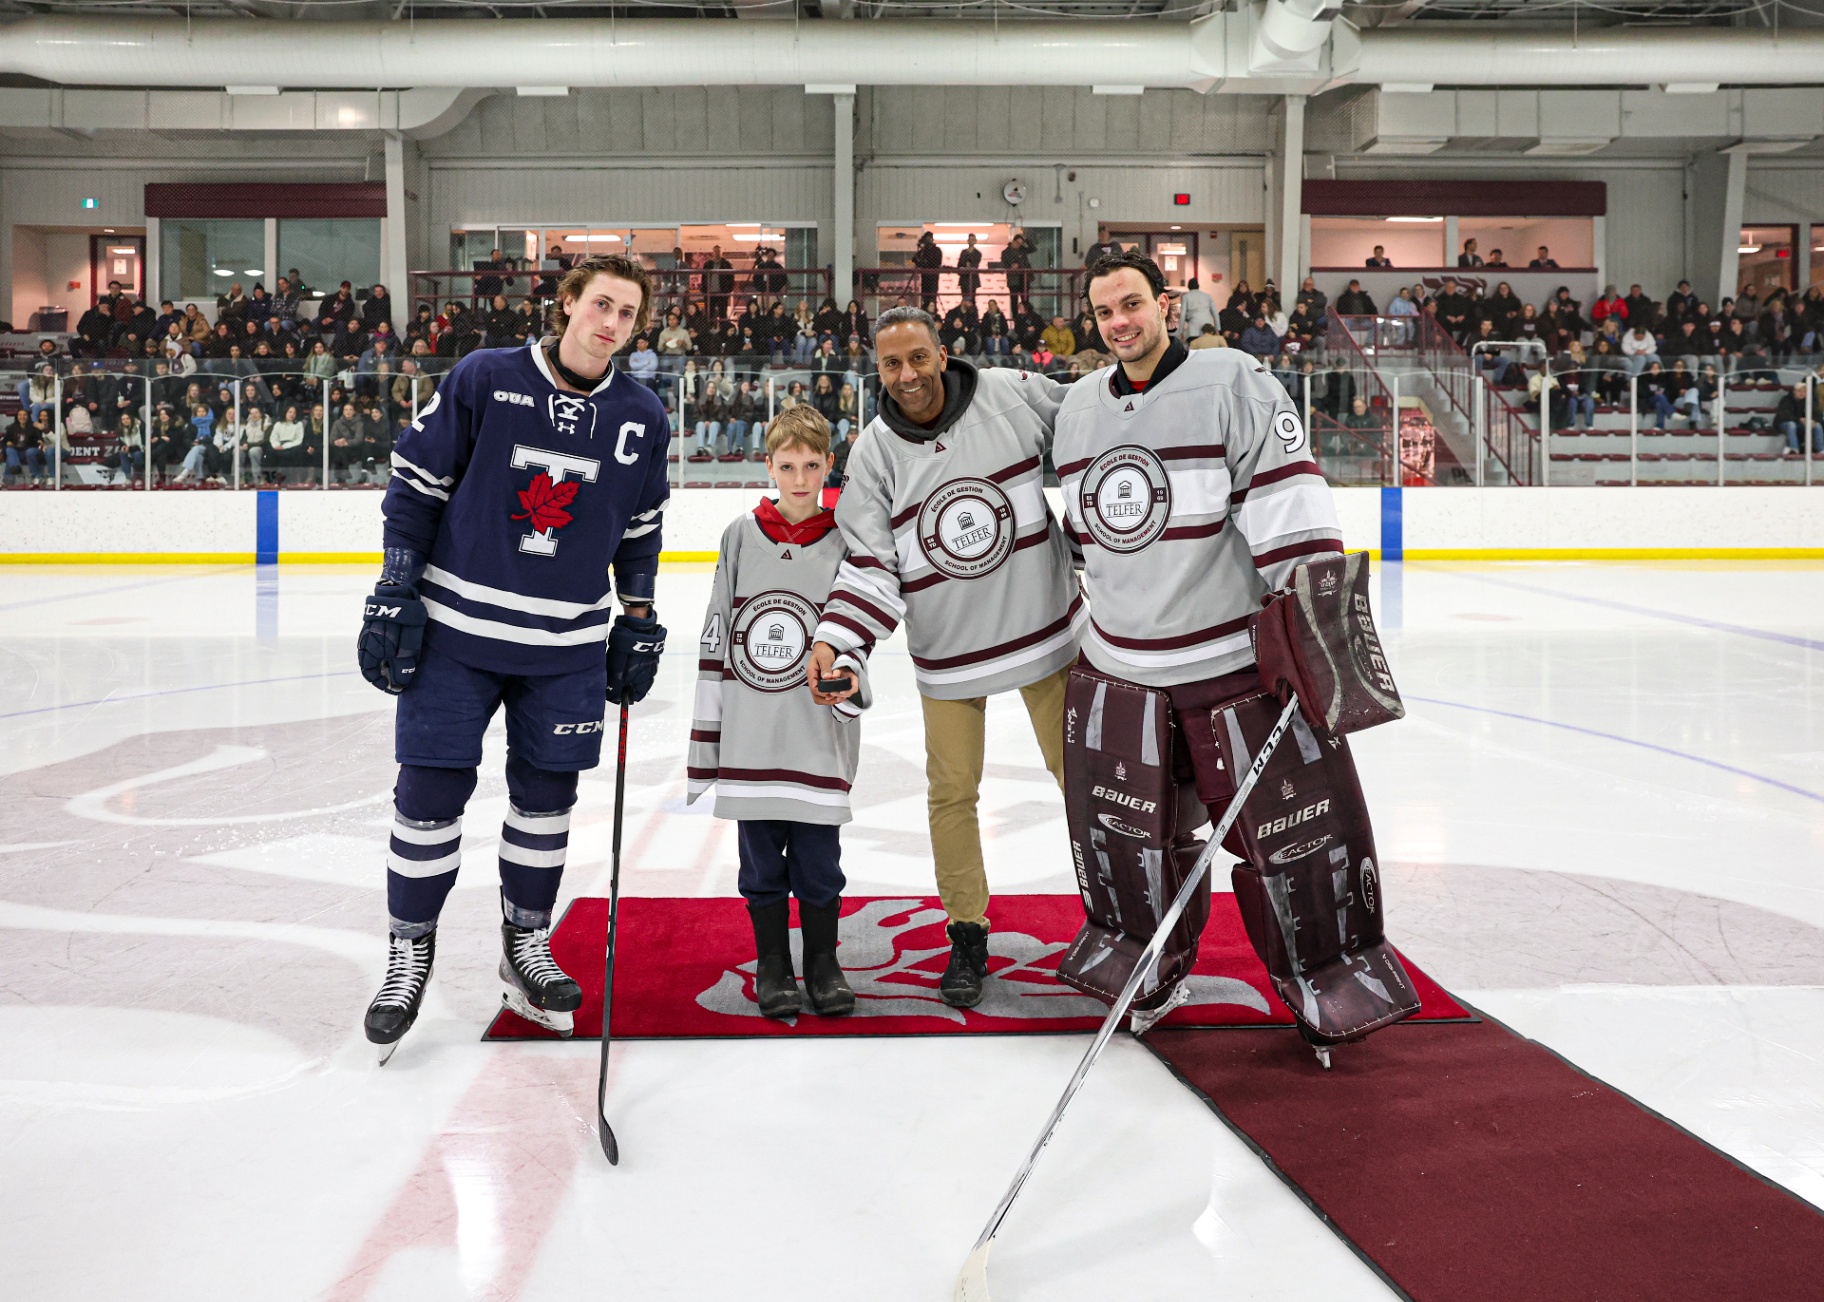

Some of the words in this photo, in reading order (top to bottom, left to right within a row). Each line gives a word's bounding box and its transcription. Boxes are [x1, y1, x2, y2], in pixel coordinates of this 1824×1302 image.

[493, 390, 535, 407] OUA
[614, 421, 646, 465] C
[1274, 410, 1306, 454] 9
[70, 447, 100, 456] DENT
[1100, 456, 1118, 472] ÉCOLE
[1118, 454, 1128, 462] DE
[1127, 453, 1150, 468] GESTION
[931, 496, 947, 512] ÉCOLE
[947, 490, 956, 498] DE
[956, 486, 984, 494] GESTION
[1106, 502, 1143, 518] TELFER
[953, 528, 992, 550] TELFER
[1093, 522, 1112, 542] SCHOOL
[1121, 520, 1157, 544] MANAGEMENT
[945, 560, 968, 571] SCHOOL
[970, 564, 979, 572] OF
[978, 535, 1008, 569] MANAGEMENT
[366, 604, 402, 618] CM
[753, 600, 772, 611] ÉCOLE
[783, 600, 807, 615] GESTION
[700, 613, 721, 653] 4
[632, 640, 665, 653] CC
[755, 645, 793, 658] TELFER
[739, 660, 756, 681] SCHOOL
[765, 665, 806, 684] MANAGEMENT
[553, 720, 604, 736] CCM
[1252, 726, 1282, 777] CCM
[1092, 785, 1156, 814] BAUER
[1257, 799, 1330, 840] BAUER
